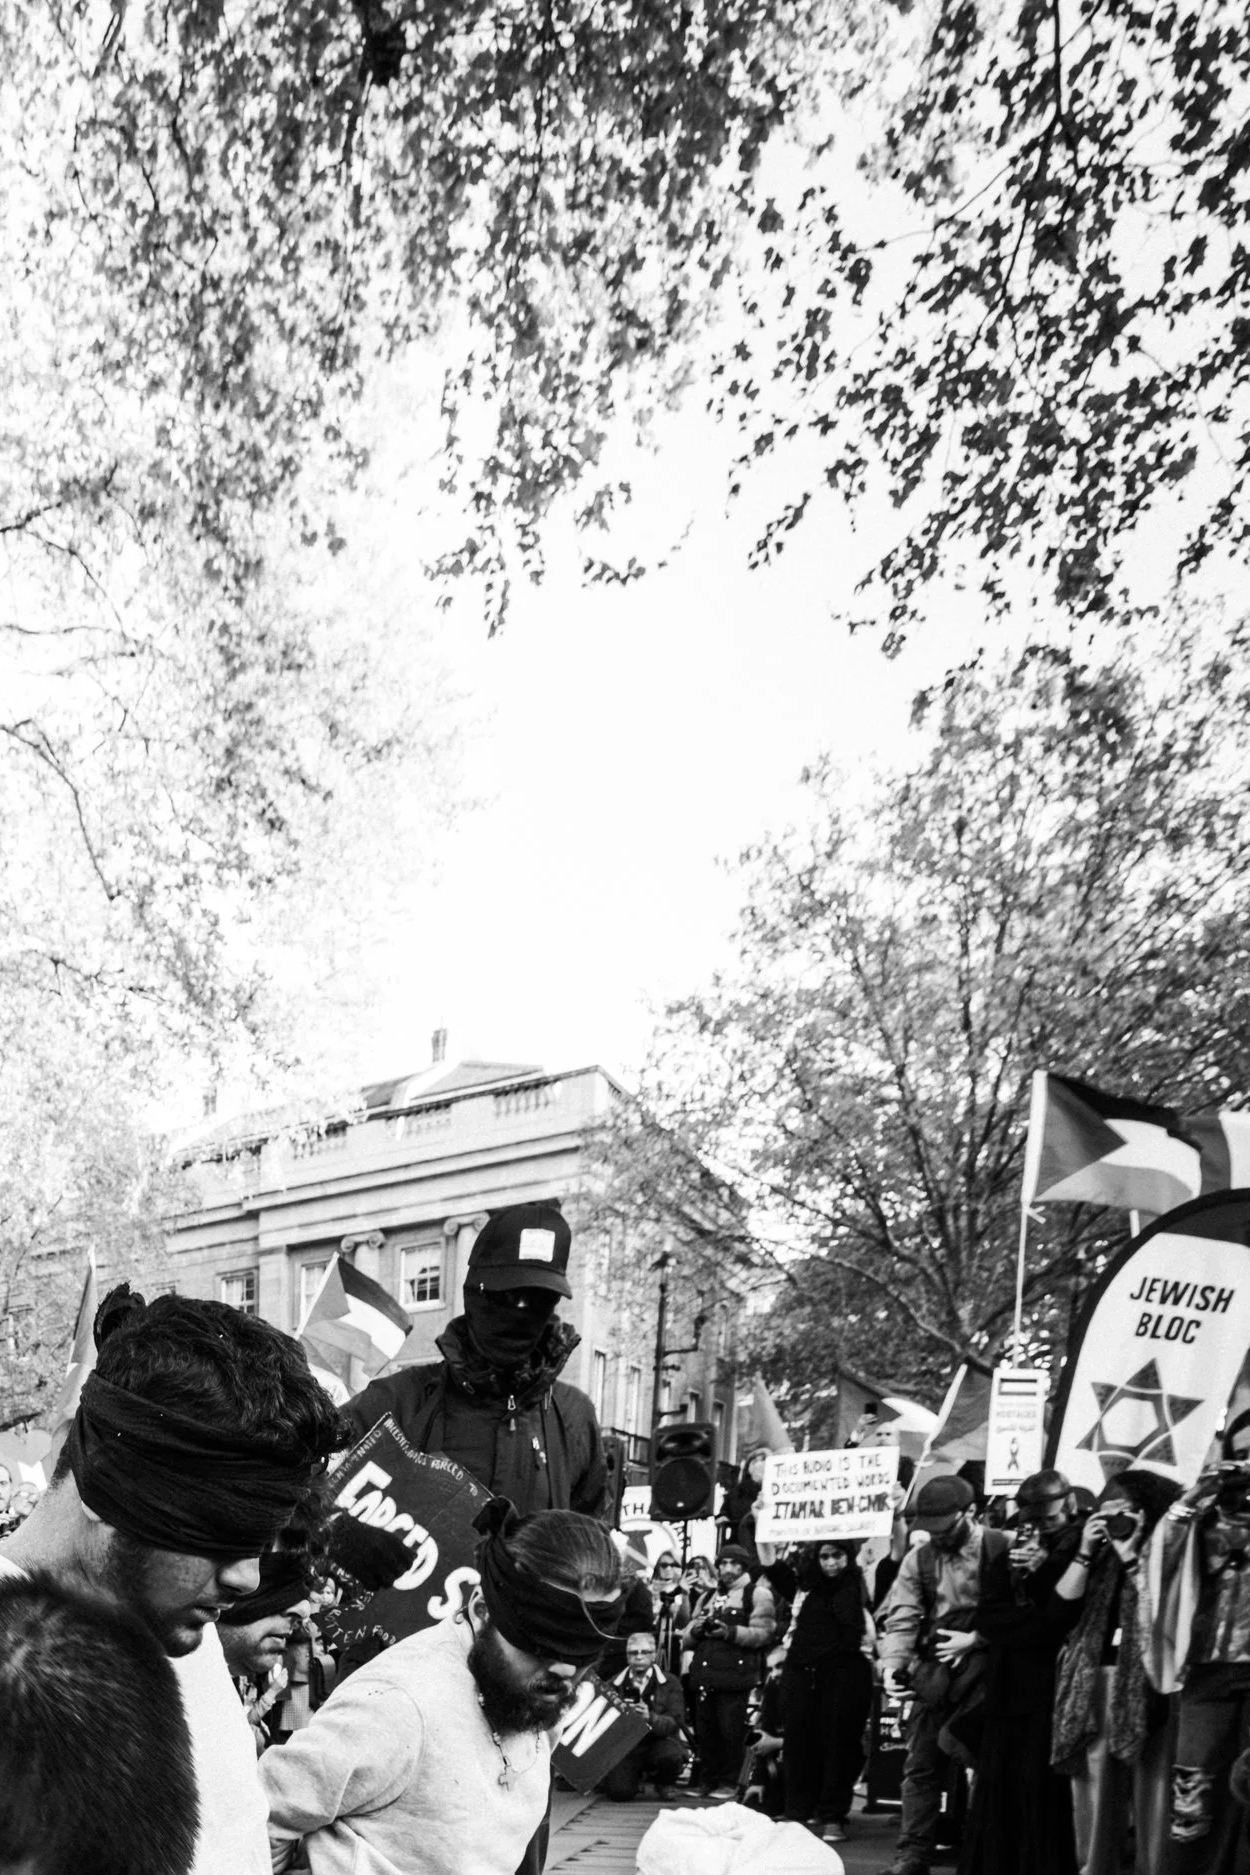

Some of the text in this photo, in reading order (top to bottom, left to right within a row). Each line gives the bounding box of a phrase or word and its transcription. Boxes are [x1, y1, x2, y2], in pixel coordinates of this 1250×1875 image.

[1130, 1276, 1235, 1314] JEWISH
[1134, 1312, 1202, 1345] BLOC
[431, 1458, 464, 1480] FORCED
[469, 1482, 479, 1497] TO
